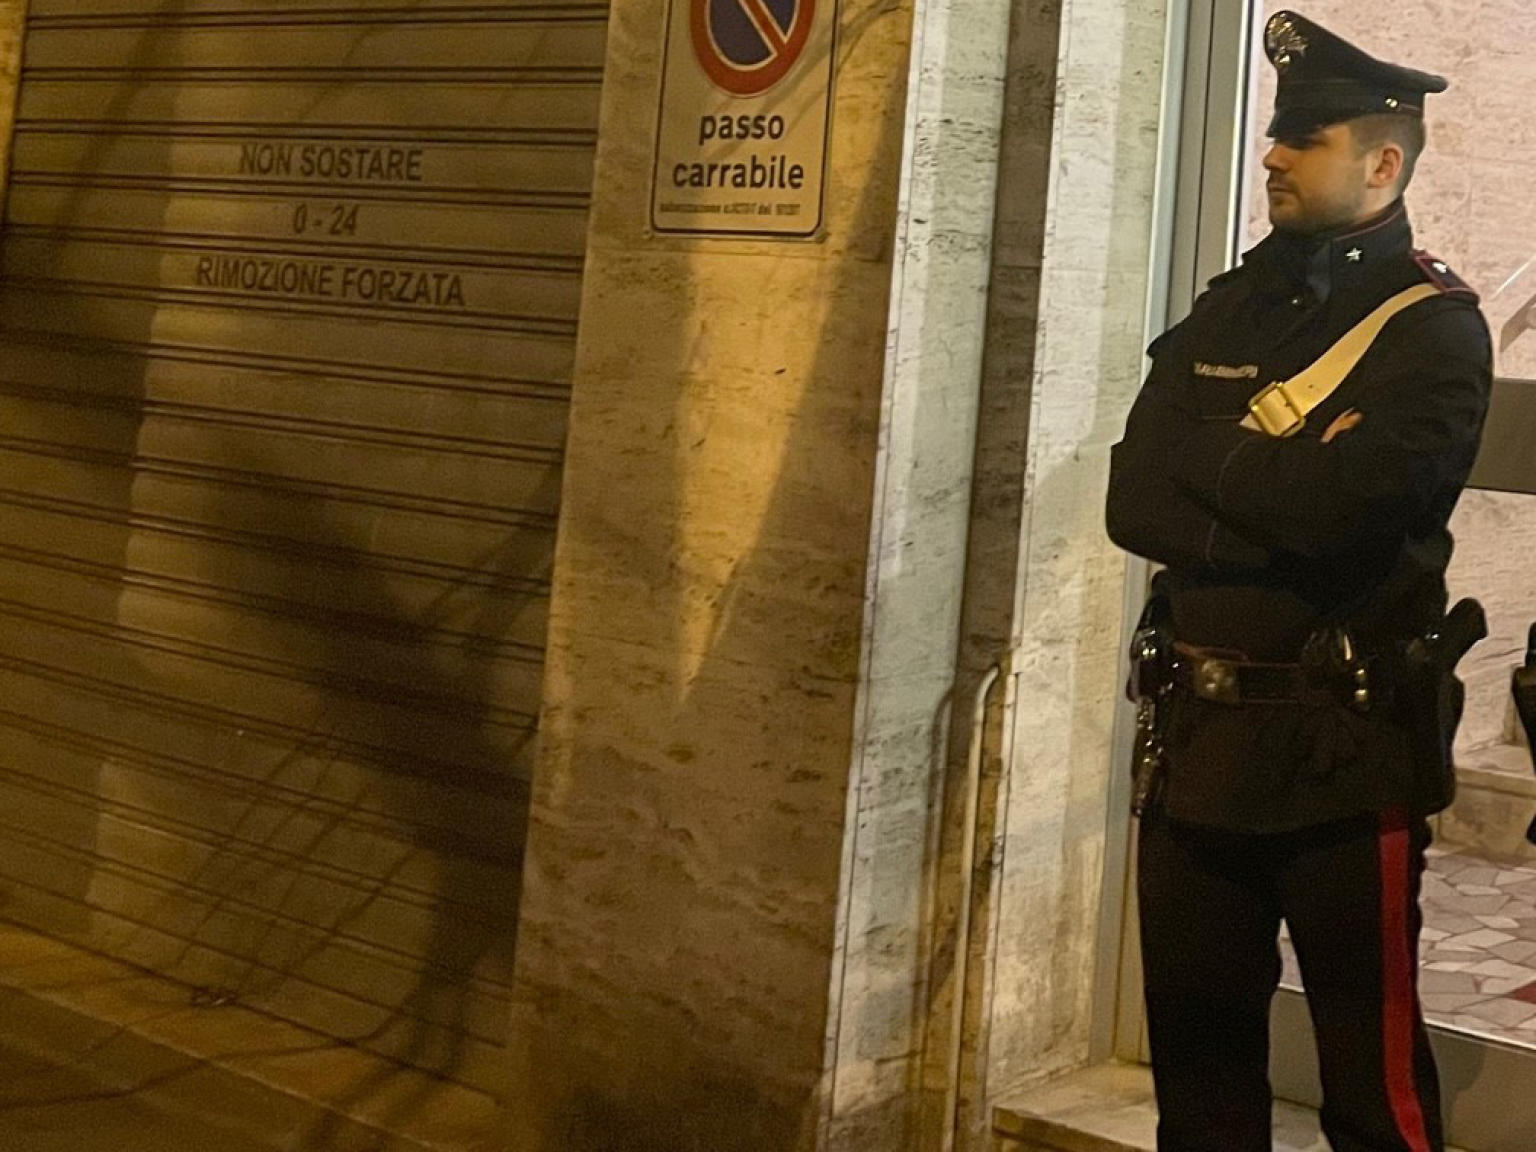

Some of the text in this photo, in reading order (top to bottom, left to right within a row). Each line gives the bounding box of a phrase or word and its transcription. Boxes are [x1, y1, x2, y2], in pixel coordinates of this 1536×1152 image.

[699, 114, 785, 145] passo
[241, 143, 422, 181] NON SOSTARE
[673, 155, 804, 190] carrabile
[328, 204, 358, 236] 24
[197, 256, 465, 306] RIMOZIONE FORZATA
